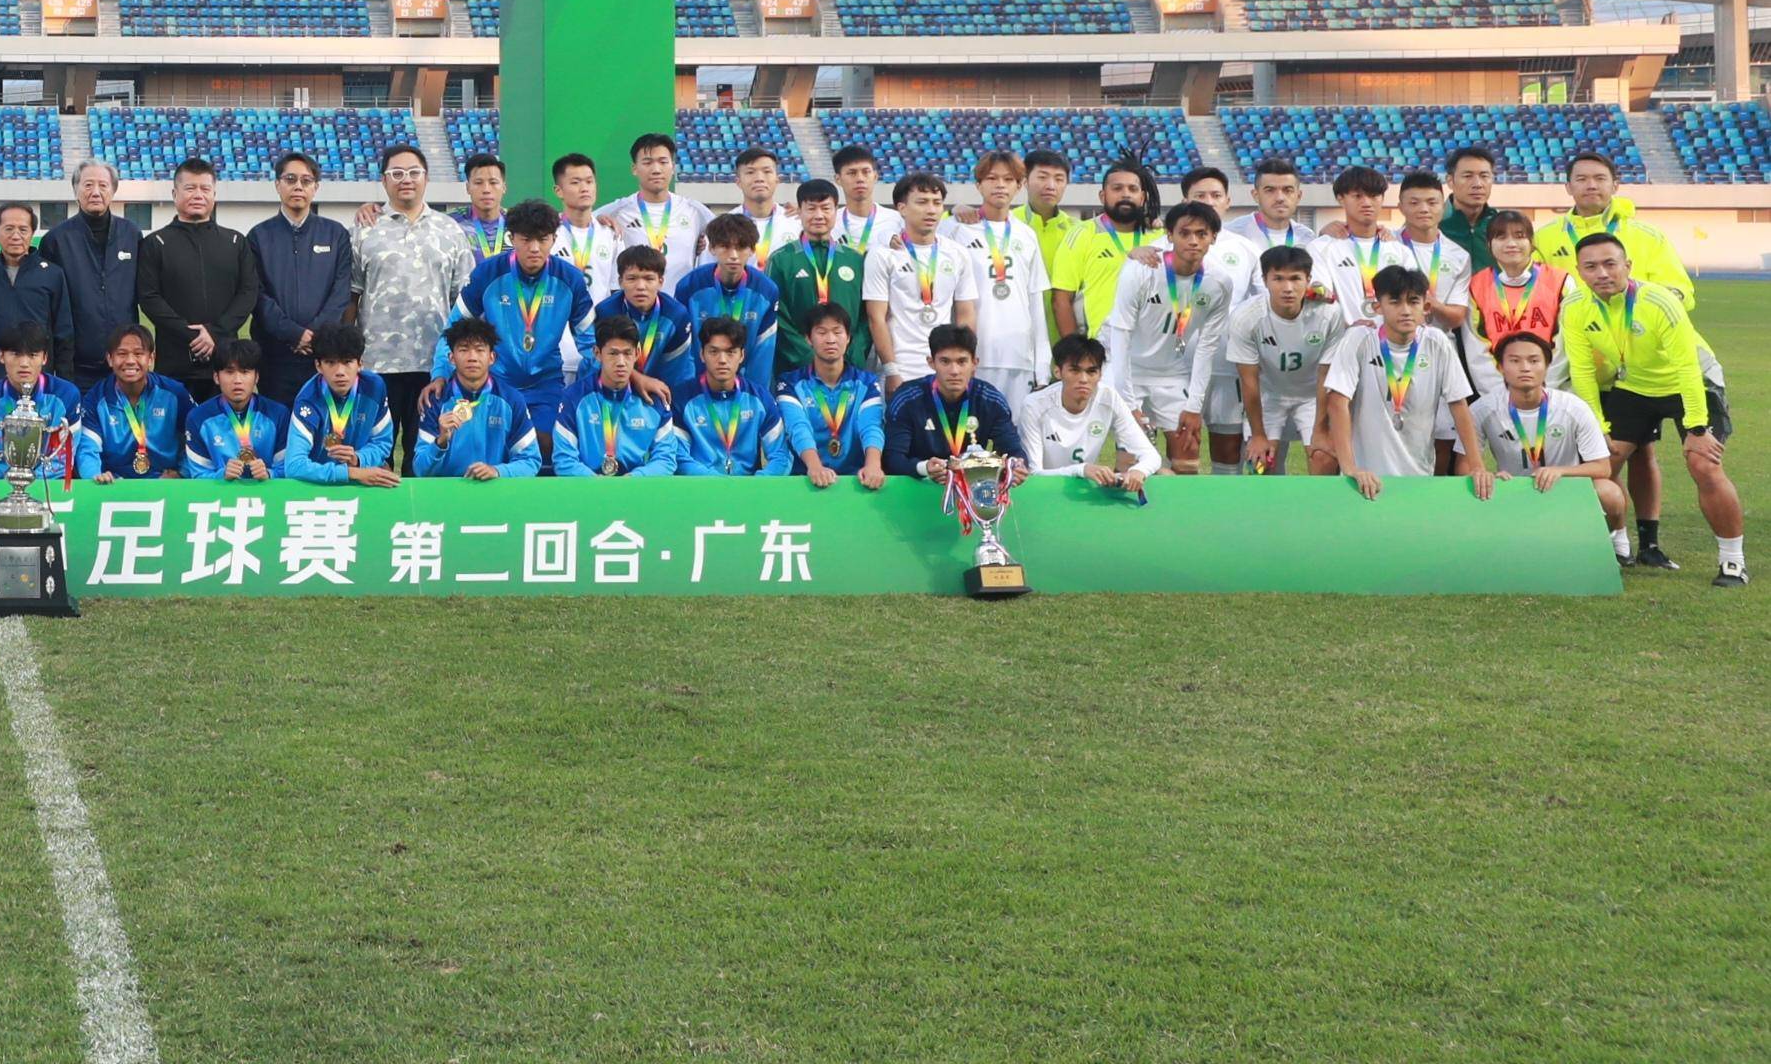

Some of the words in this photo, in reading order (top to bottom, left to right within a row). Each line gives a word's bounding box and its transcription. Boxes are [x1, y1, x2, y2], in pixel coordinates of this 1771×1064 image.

[1280, 352, 1302, 372] 13
[390, 519, 813, 584] 第二回合·广东
